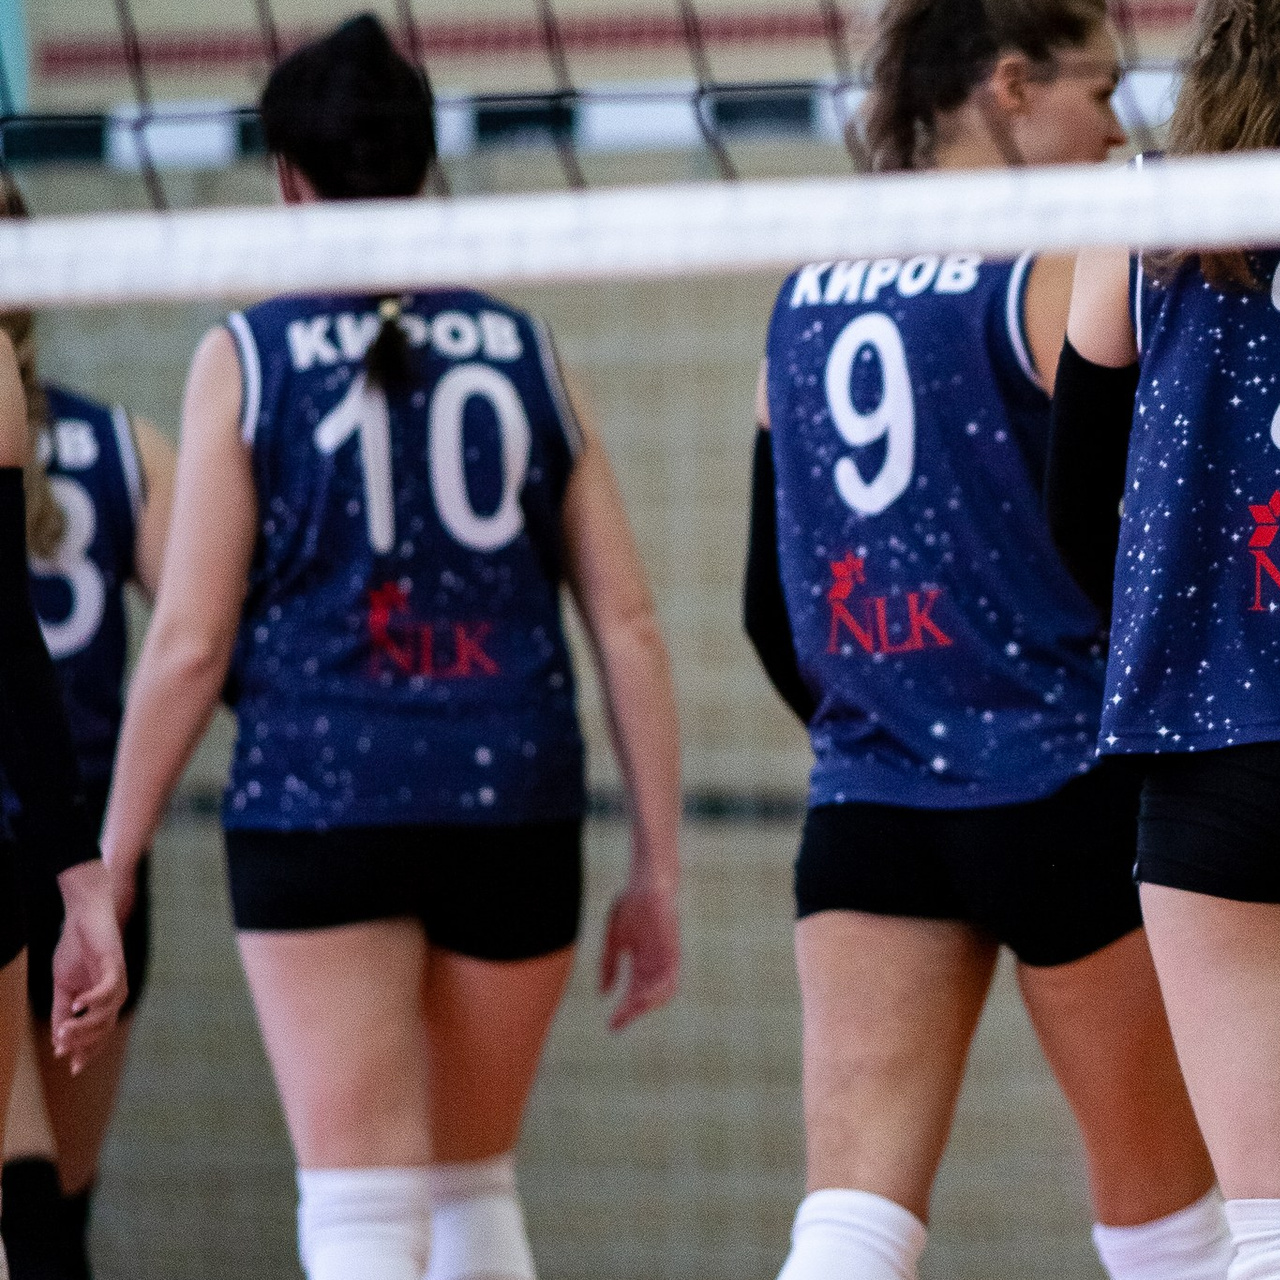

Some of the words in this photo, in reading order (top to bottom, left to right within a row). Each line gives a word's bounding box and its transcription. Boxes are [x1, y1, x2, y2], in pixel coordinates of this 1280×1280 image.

[789, 252, 983, 309] КИРОВ
[315, 363, 531, 553] 10
[824, 311, 915, 516] 9
[827, 588, 953, 654] NLK
